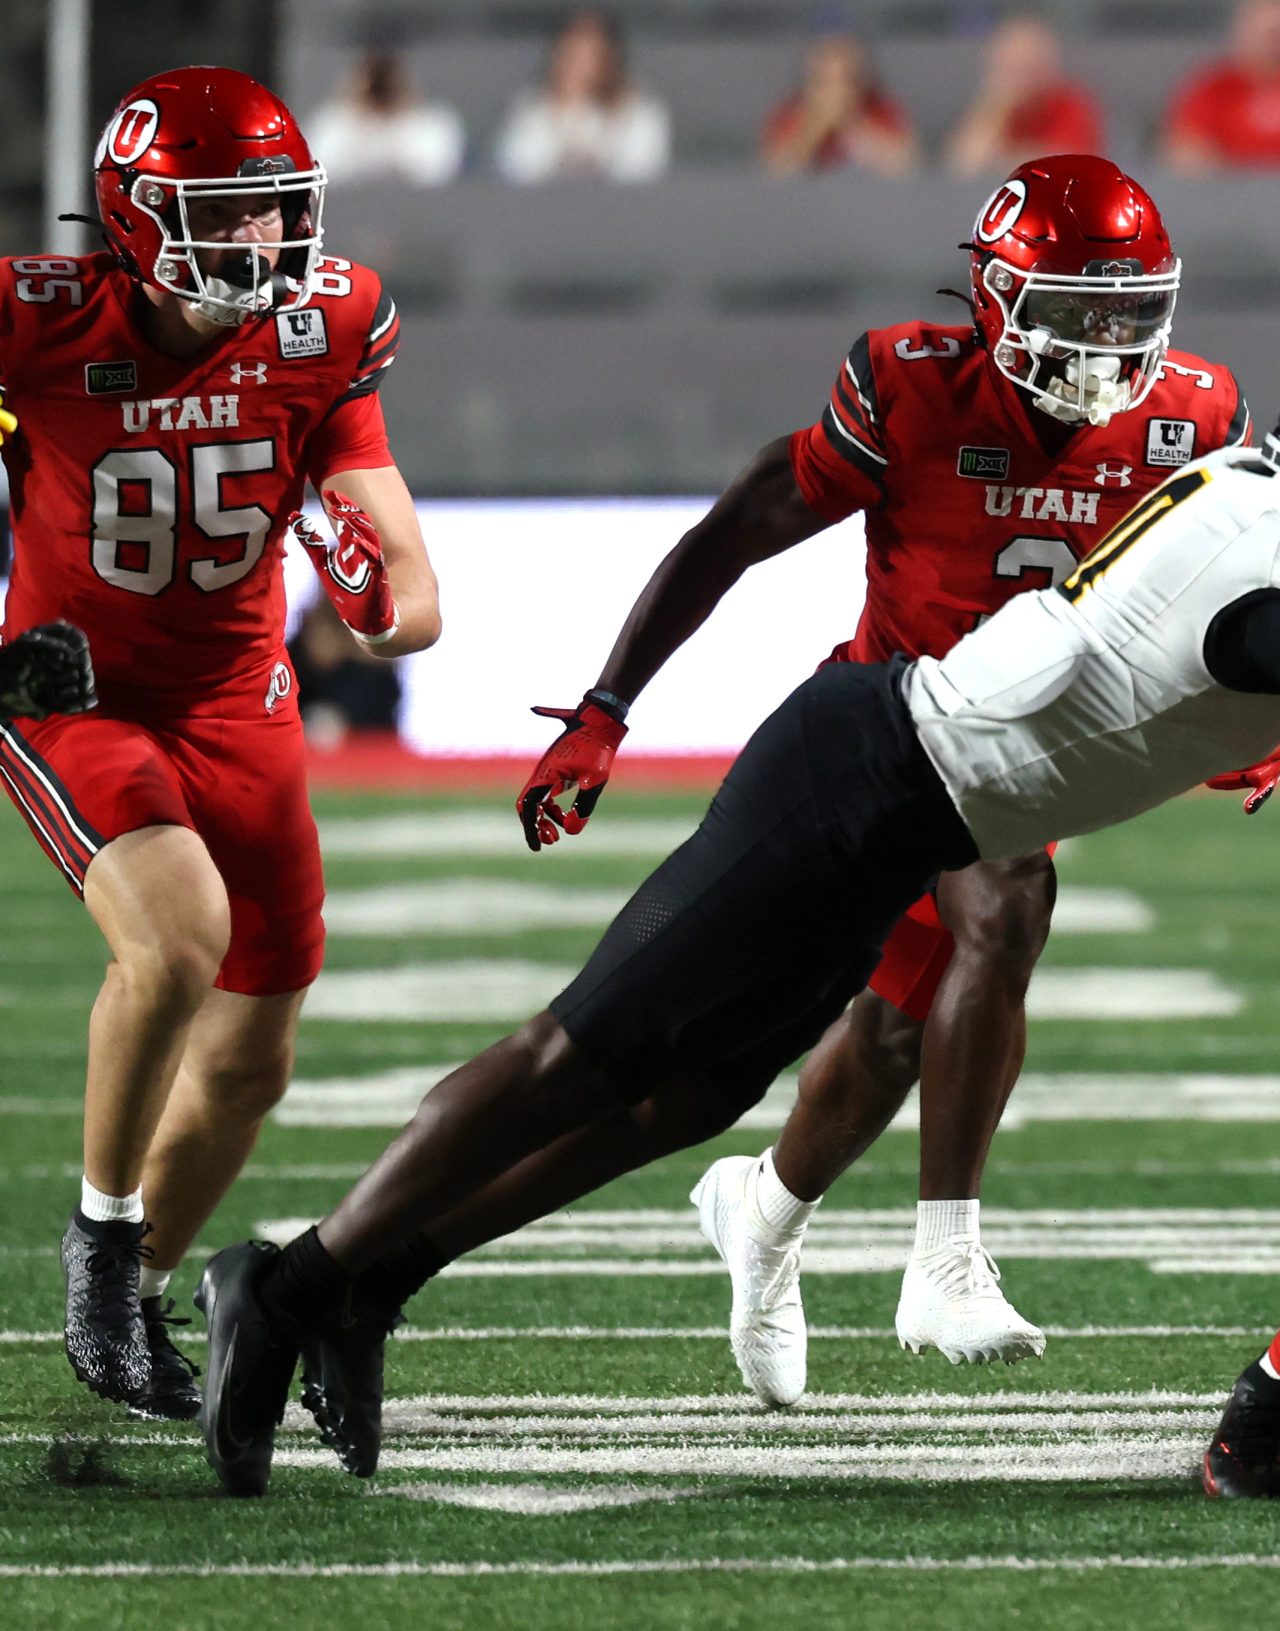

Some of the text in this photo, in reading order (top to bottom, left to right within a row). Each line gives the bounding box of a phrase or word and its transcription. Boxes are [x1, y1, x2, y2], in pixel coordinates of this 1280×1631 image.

[11, 259, 82, 306] 85
[283, 338, 325, 351] HEALTH
[894, 336, 960, 361] 3
[121, 395, 239, 433] UTAH
[1150, 447, 1190, 460] HEALTH
[91, 437, 275, 597] 85
[985, 485, 1100, 524] UTAH
